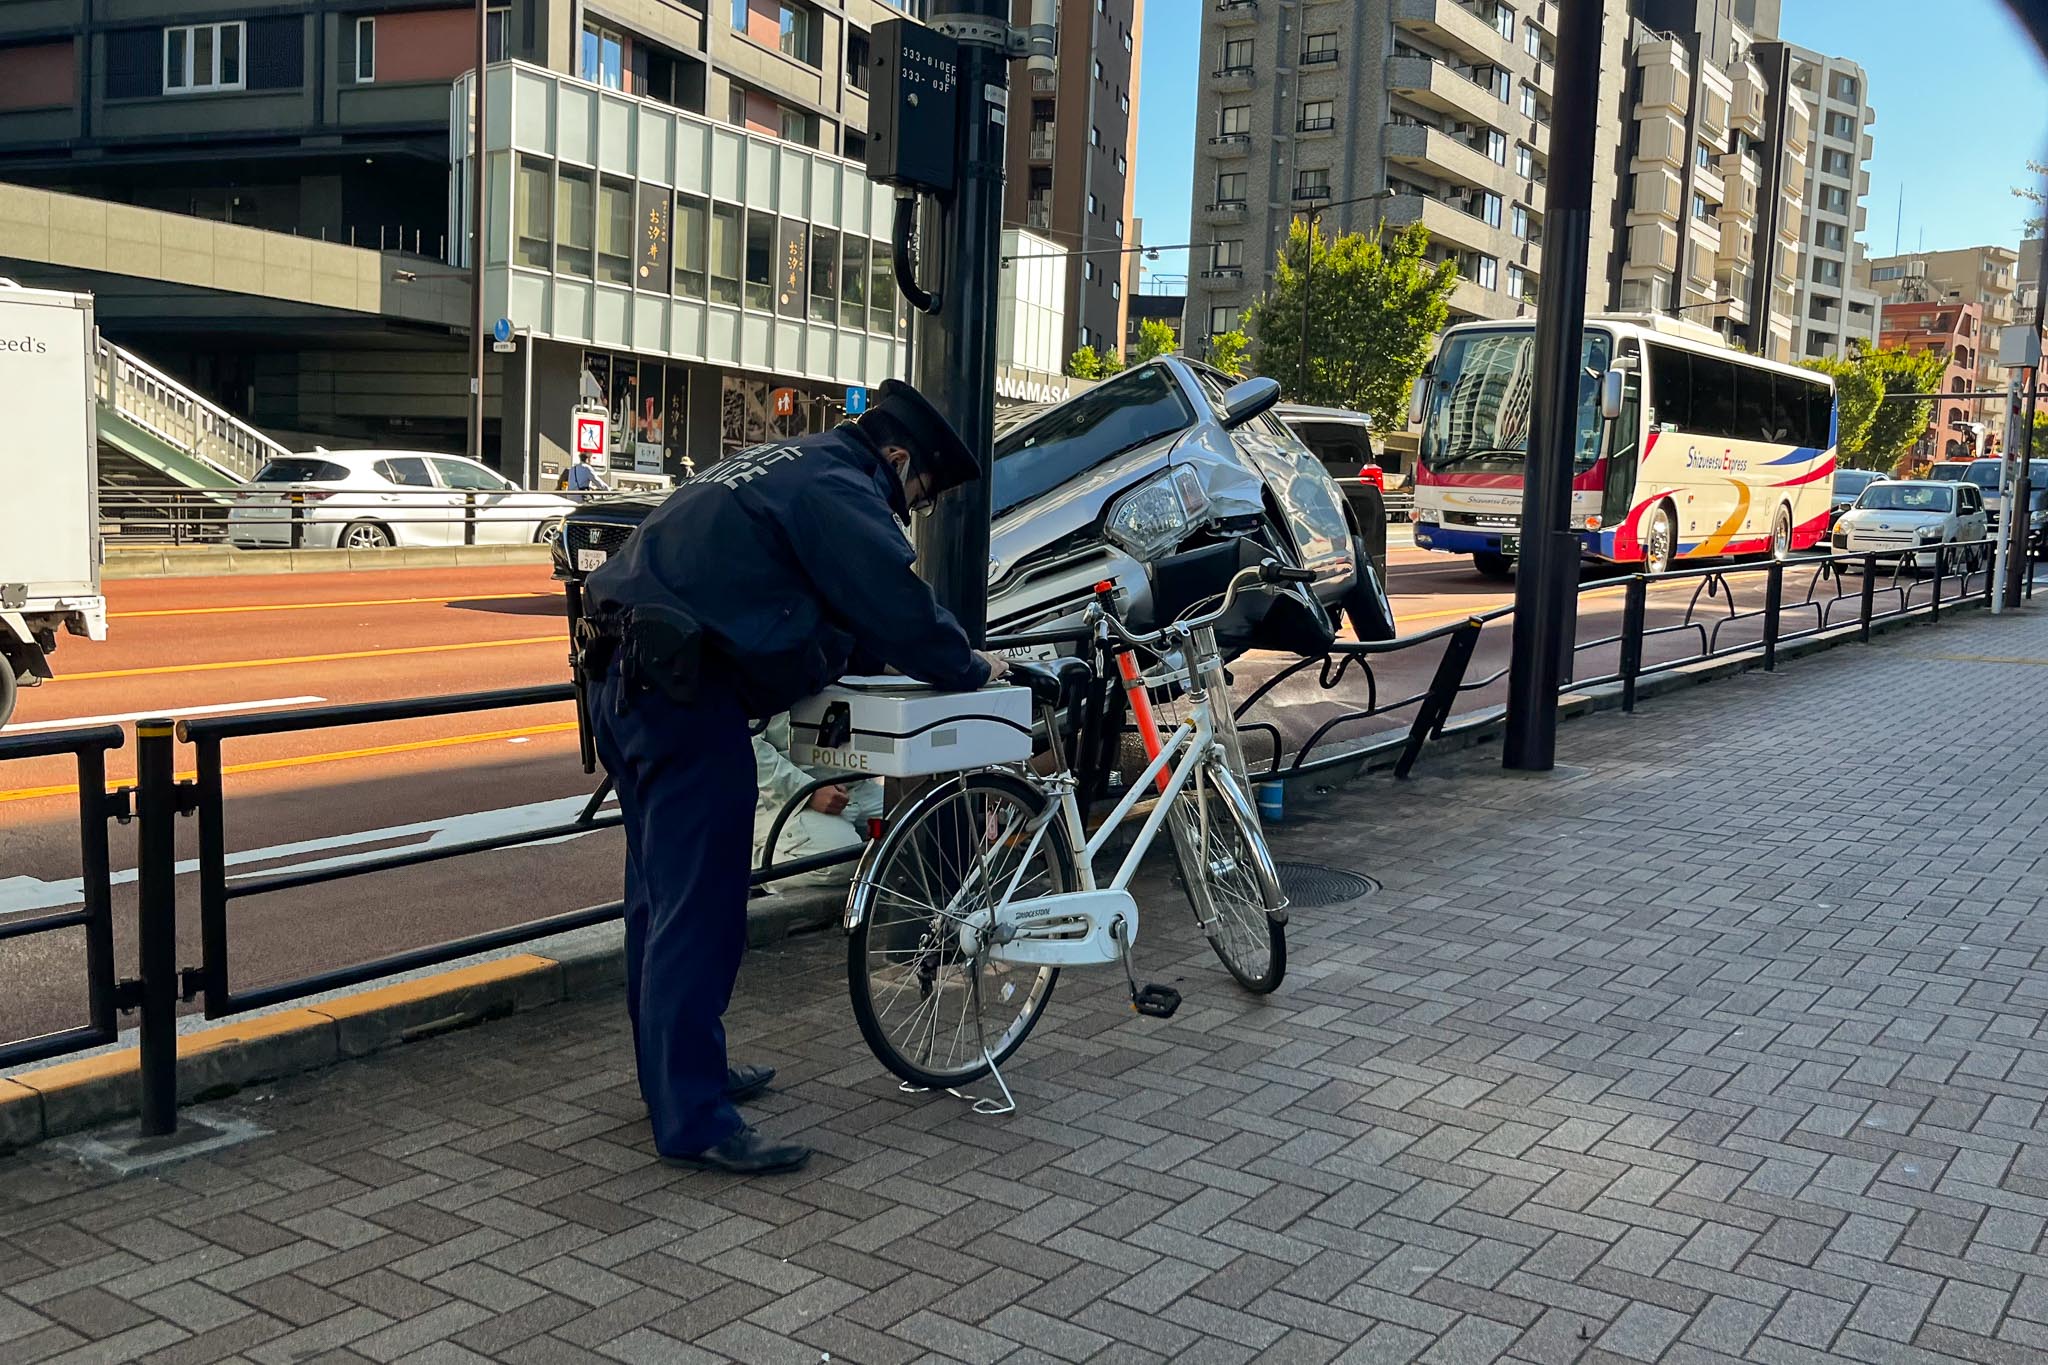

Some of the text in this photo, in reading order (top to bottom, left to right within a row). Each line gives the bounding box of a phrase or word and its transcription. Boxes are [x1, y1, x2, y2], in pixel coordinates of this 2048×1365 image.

[1686, 445, 1748, 475] Shizutetsu Express
[812, 748, 868, 770] POLICE
